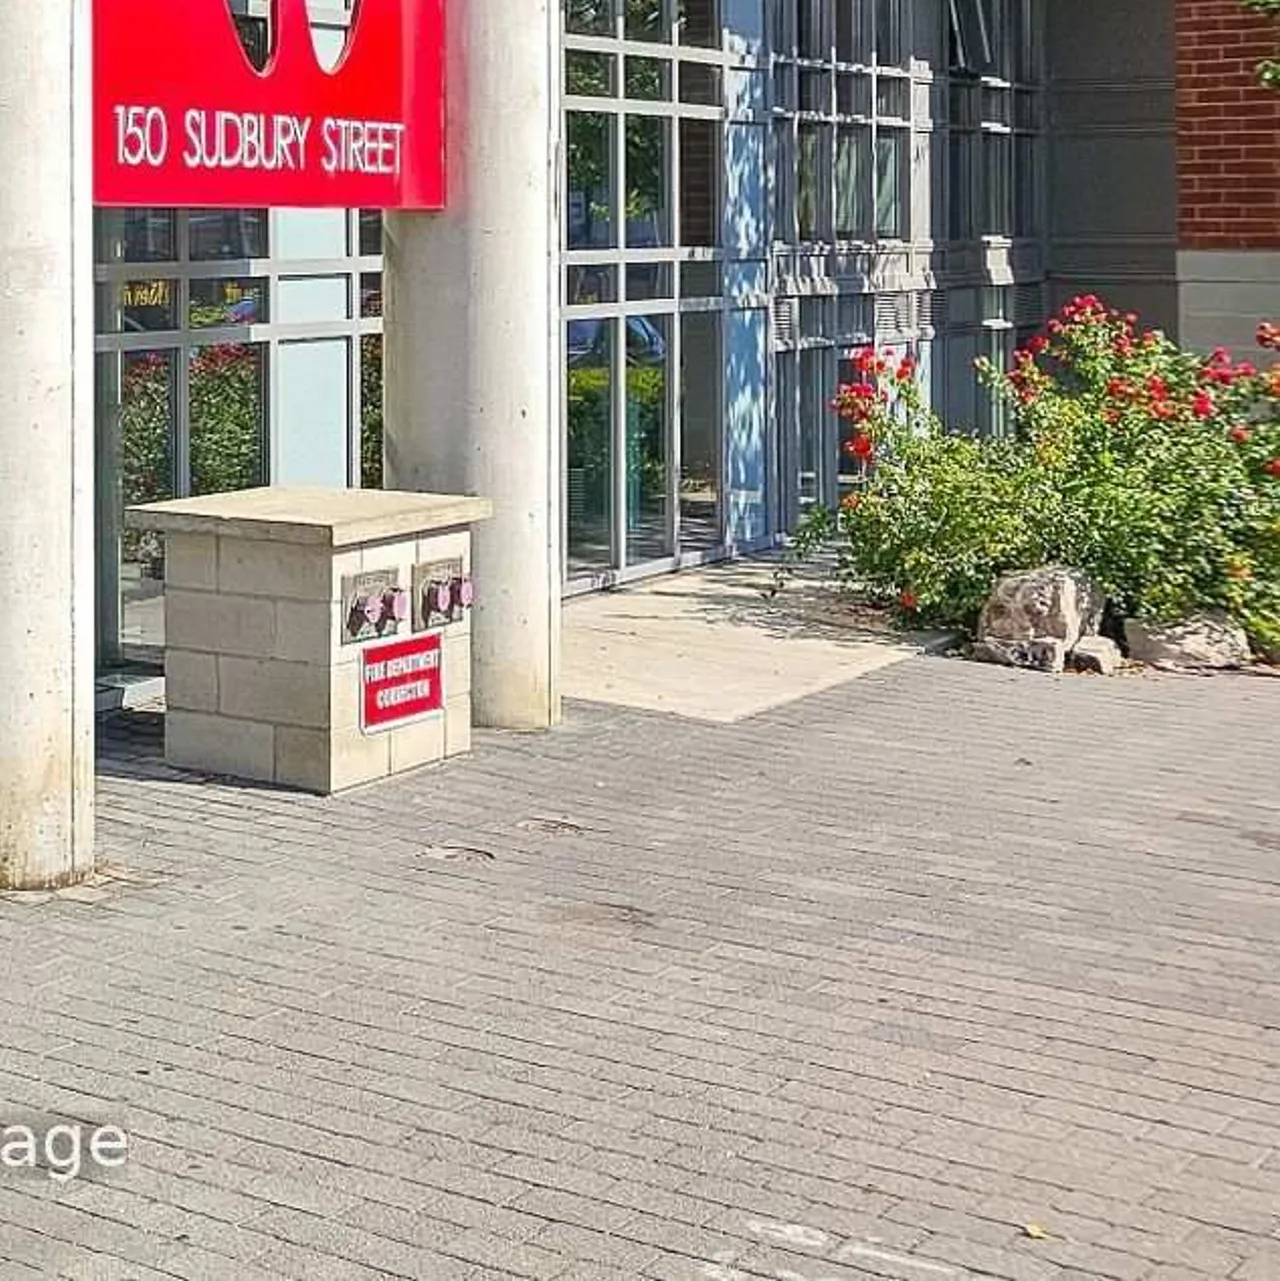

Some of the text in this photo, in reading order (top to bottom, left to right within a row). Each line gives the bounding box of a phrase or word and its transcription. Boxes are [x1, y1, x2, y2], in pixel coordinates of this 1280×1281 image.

[114, 105, 405, 175] 150 SUDBURY STREET
